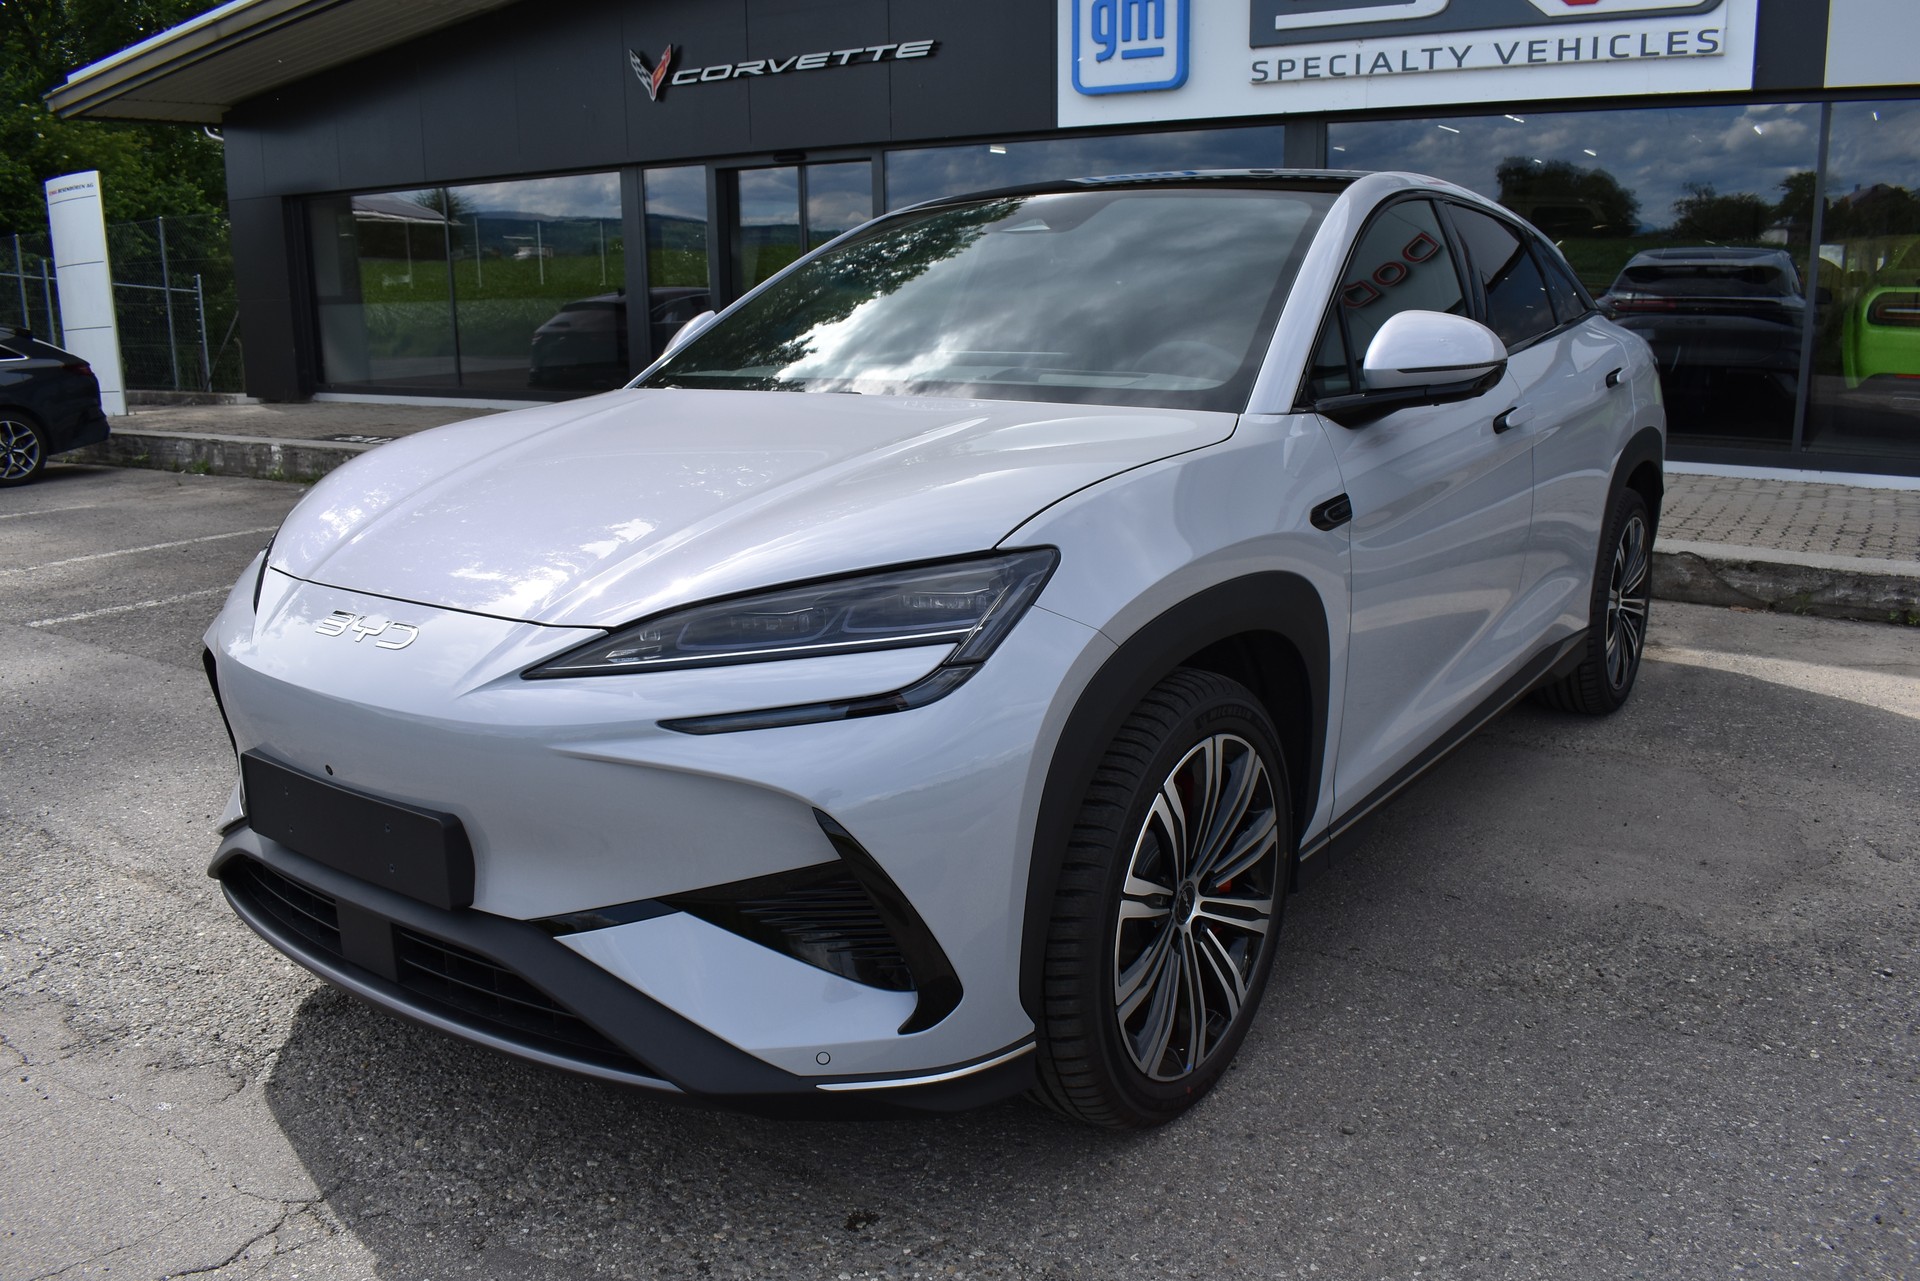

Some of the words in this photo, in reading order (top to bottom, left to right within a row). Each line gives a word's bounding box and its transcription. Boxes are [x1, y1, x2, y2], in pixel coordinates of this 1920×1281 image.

[1092, 0, 1165, 64] gm
[1251, 45, 1473, 82] SPECIALTY
[1493, 29, 1719, 65] VEHICLES
[672, 40, 935, 86] CORVETTE
[315, 610, 419, 650] BYD
